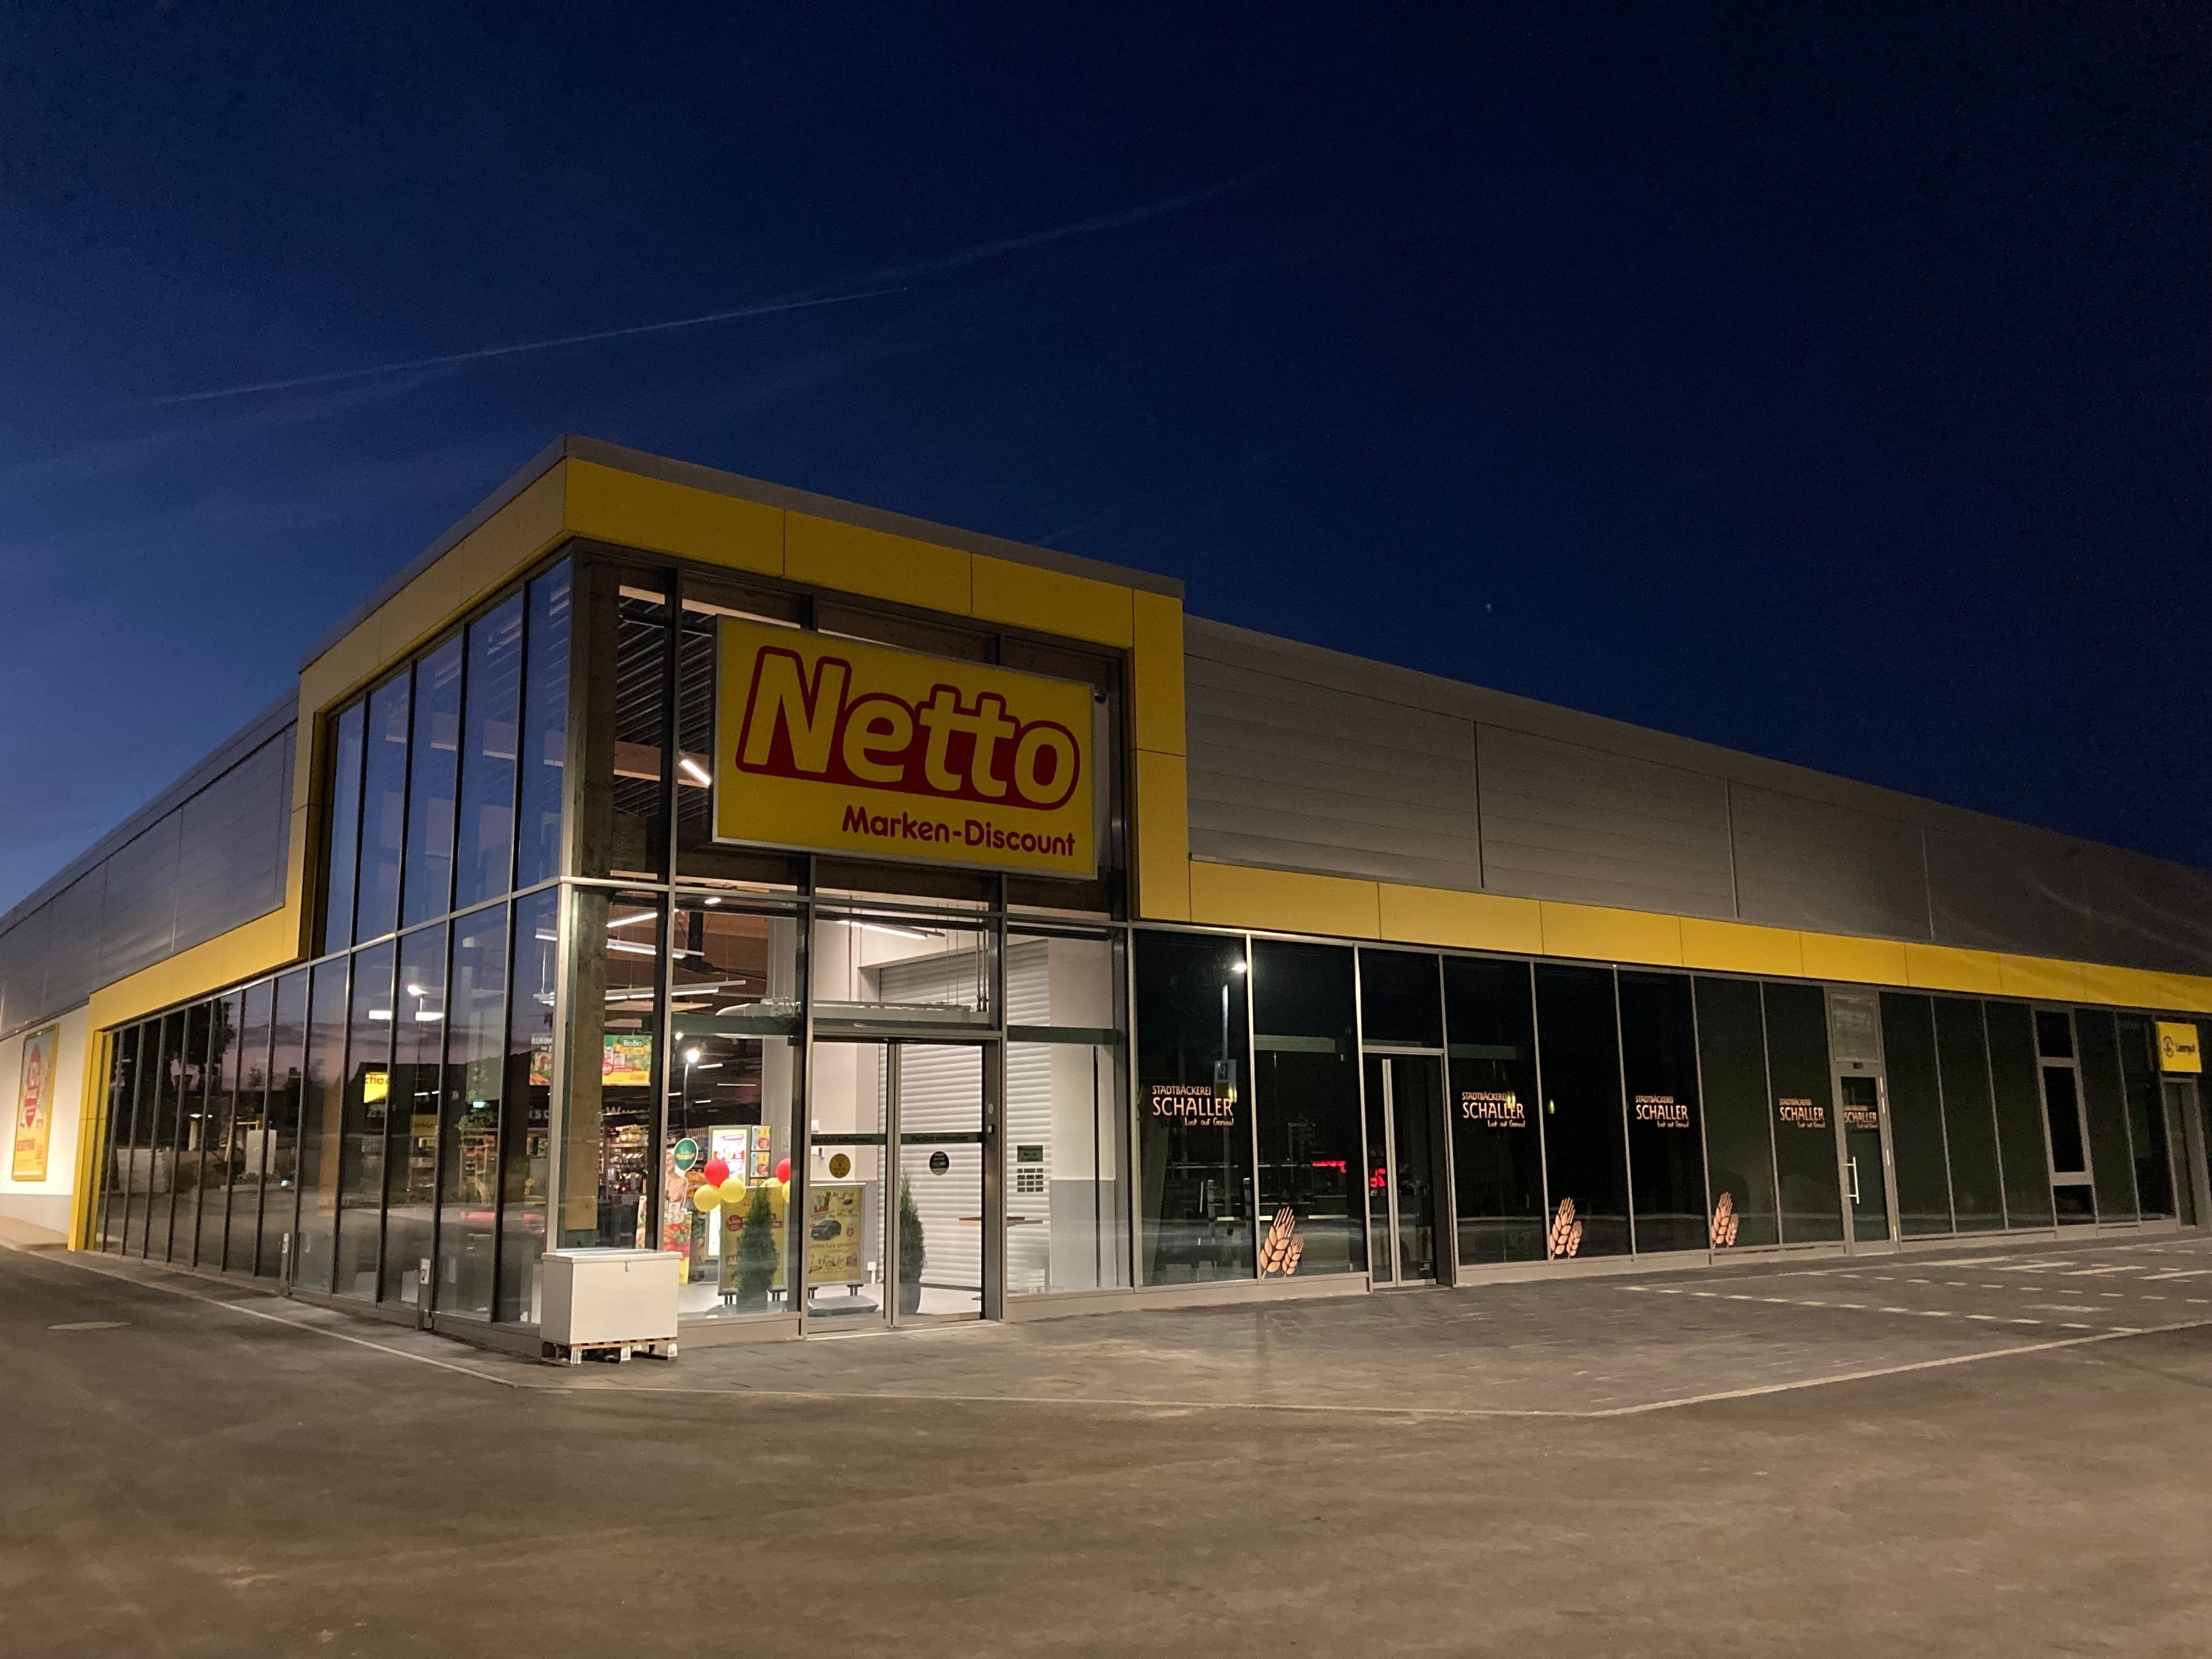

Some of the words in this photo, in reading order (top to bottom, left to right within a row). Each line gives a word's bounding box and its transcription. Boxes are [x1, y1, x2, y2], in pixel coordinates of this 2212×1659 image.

[736, 646, 1080, 810] Netto
[842, 805, 1075, 857] Marken-Discount
[1152, 1097, 1233, 1116] SCHALLER
[1463, 1101, 1525, 1119] SCHALLER
[1636, 1104, 1689, 1120] SCHALLER
[1779, 1106, 1825, 1121] SCHALLER
[1843, 1111, 1877, 1123] SCHALLER
